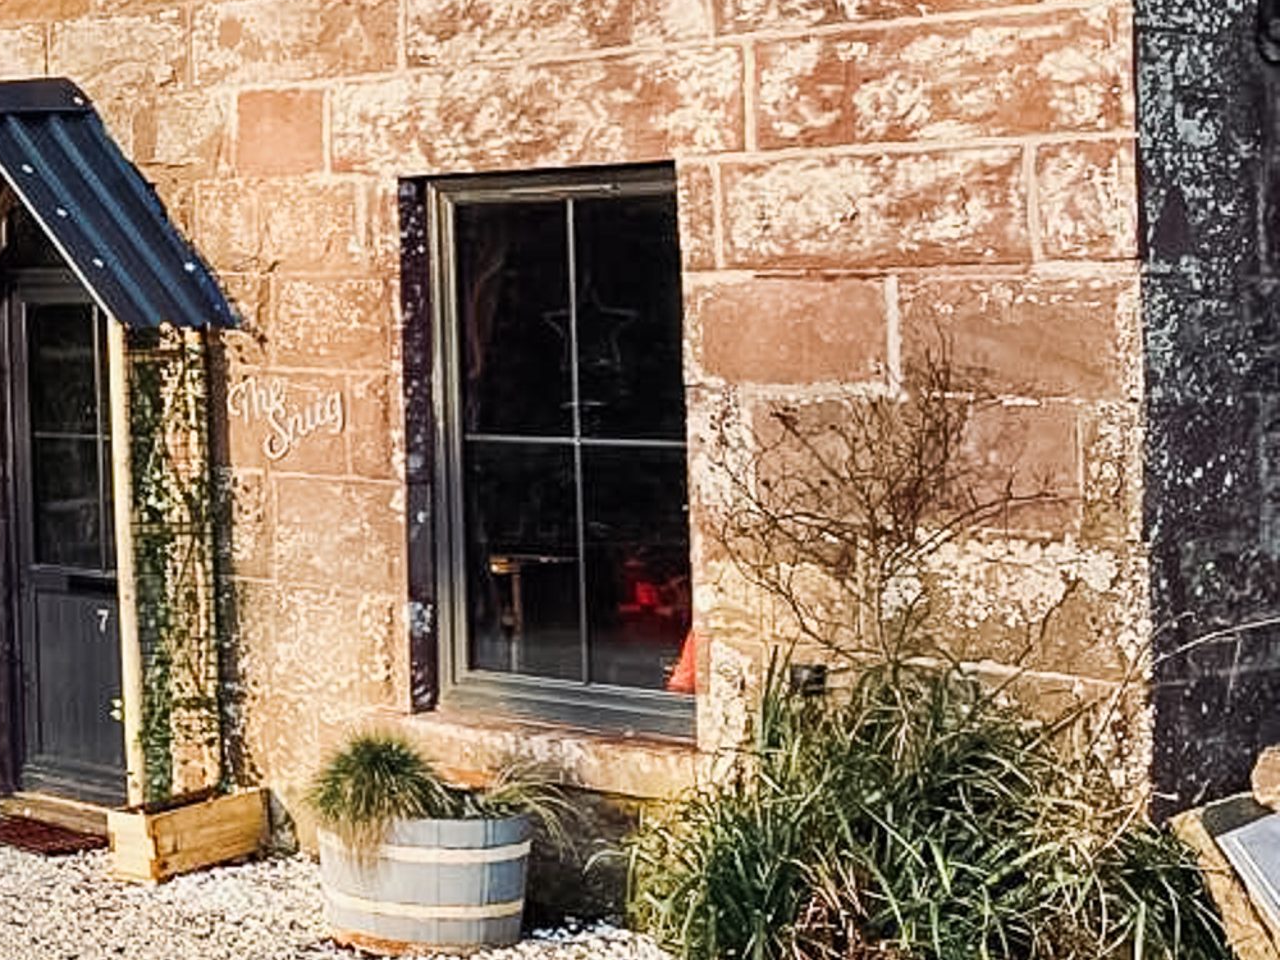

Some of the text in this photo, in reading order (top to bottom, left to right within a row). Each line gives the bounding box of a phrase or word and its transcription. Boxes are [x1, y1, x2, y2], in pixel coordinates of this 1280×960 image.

[227, 377, 286, 423] The
[264, 391, 345, 460] Snug
[97, 609, 109, 633] 7
